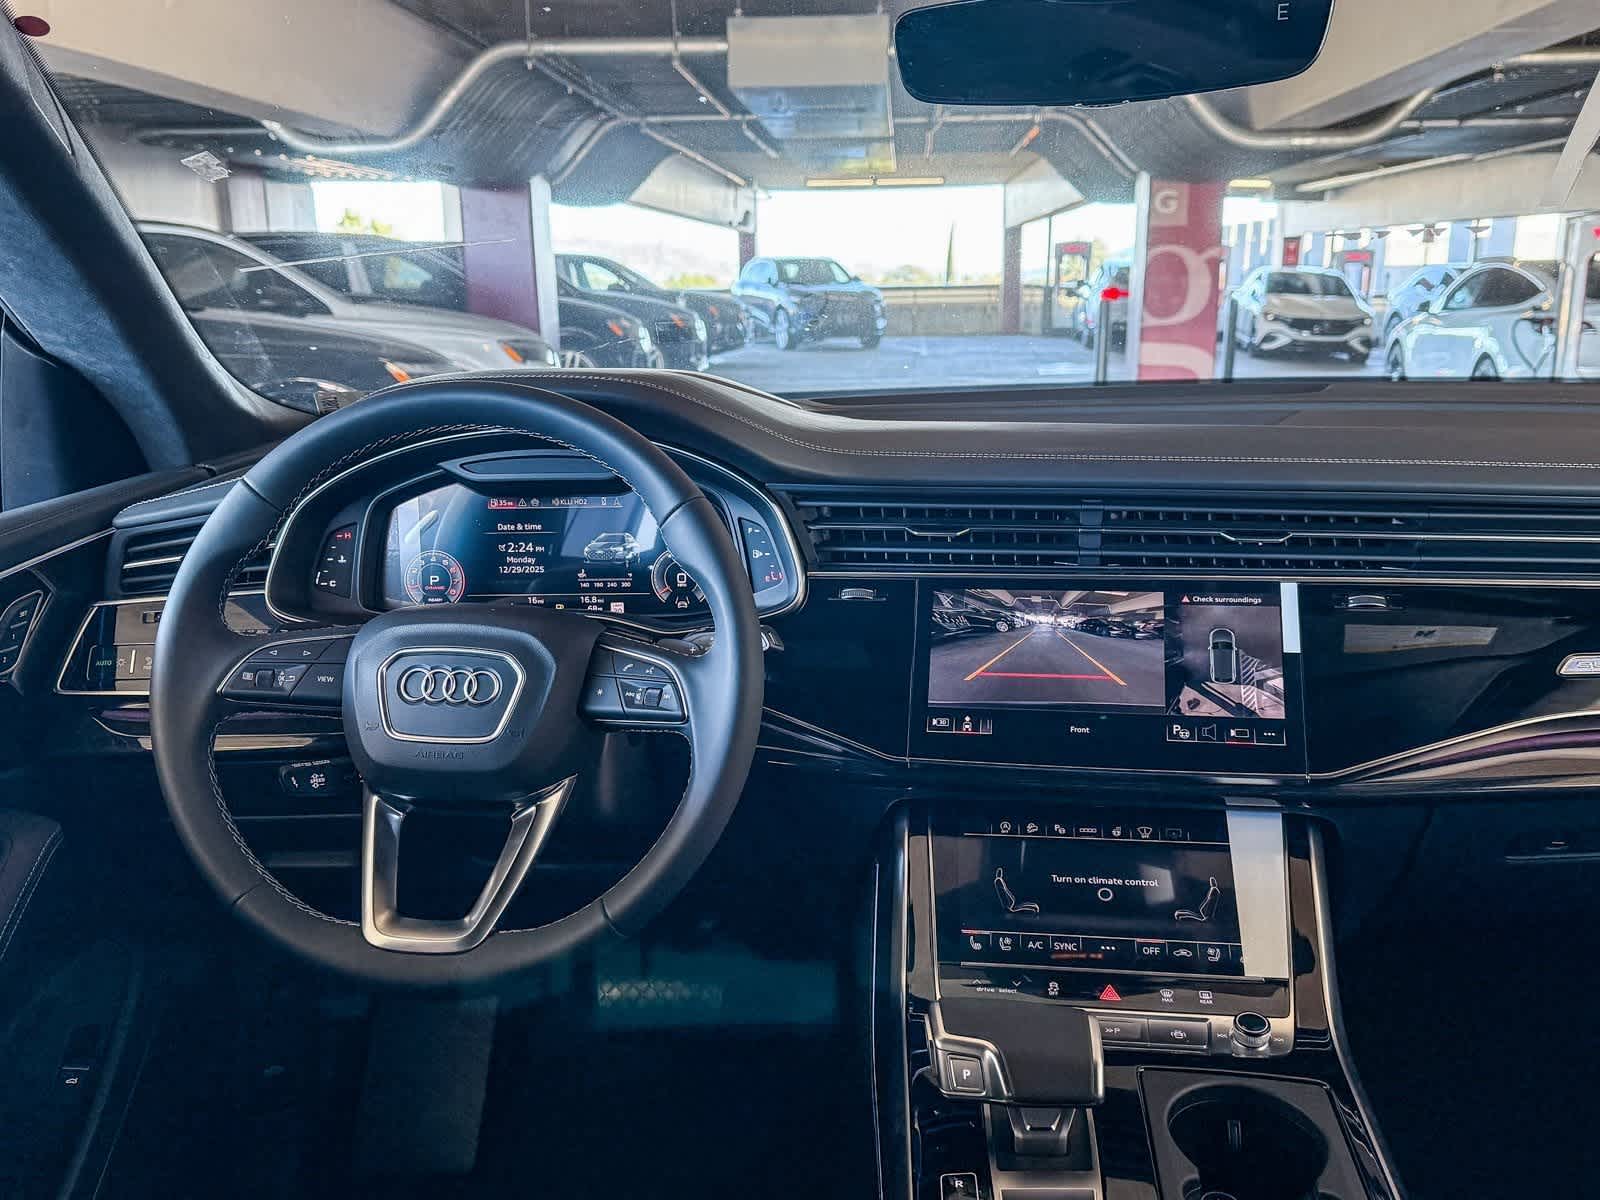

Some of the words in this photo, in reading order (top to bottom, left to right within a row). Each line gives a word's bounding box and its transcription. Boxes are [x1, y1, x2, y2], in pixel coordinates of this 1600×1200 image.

[1277, 4, 1289, 21] E
[1154, 190, 1179, 214] G
[497, 523, 516, 531] Date
[517, 523, 523, 531] &
[524, 523, 542, 531] time
[507, 542, 534, 553] 2:24
[506, 556, 536, 564] Monday
[498, 566, 545, 574] 12/29/2025
[429, 575, 440, 585] P
[1214, 596, 1262, 605] surroundings
[317, 675, 335, 683] VIEW
[1070, 726, 1090, 734] Front
[1050, 874, 1073, 883] Turn
[1074, 876, 1086, 884] on
[1088, 876, 1123, 885] climate
[1124, 879, 1160, 887] control
[1028, 941, 1044, 950] A/C
[1053, 942, 1078, 951] SYNC
[1142, 946, 1160, 955] OFF
[962, 1069, 971, 1080] P
[954, 1180, 964, 1188] R
